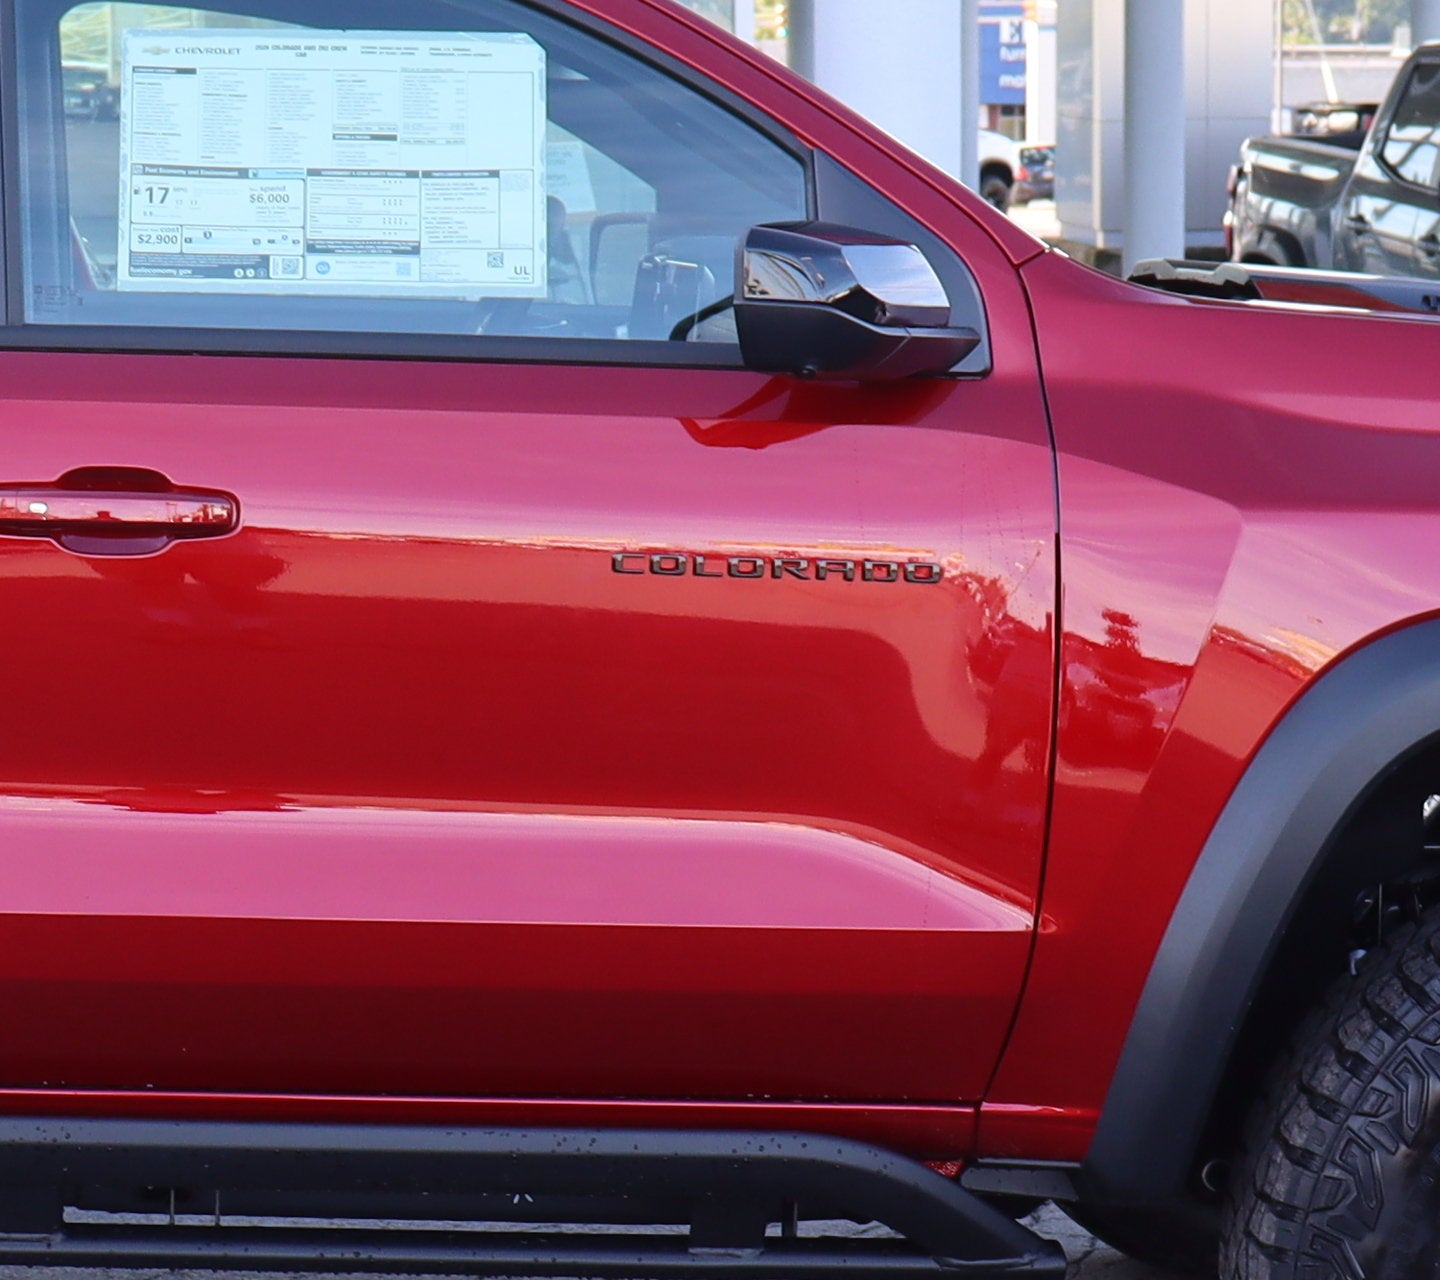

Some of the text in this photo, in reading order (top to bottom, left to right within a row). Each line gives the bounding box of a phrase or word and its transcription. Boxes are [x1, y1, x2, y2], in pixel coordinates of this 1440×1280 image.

[174, 46, 242, 56] CHEVROLET
[145, 186, 169, 204] 17
[249, 193, 290, 205] $6,000
[137, 233, 178, 246] $2,900
[611, 552, 944, 584] COLORADO
